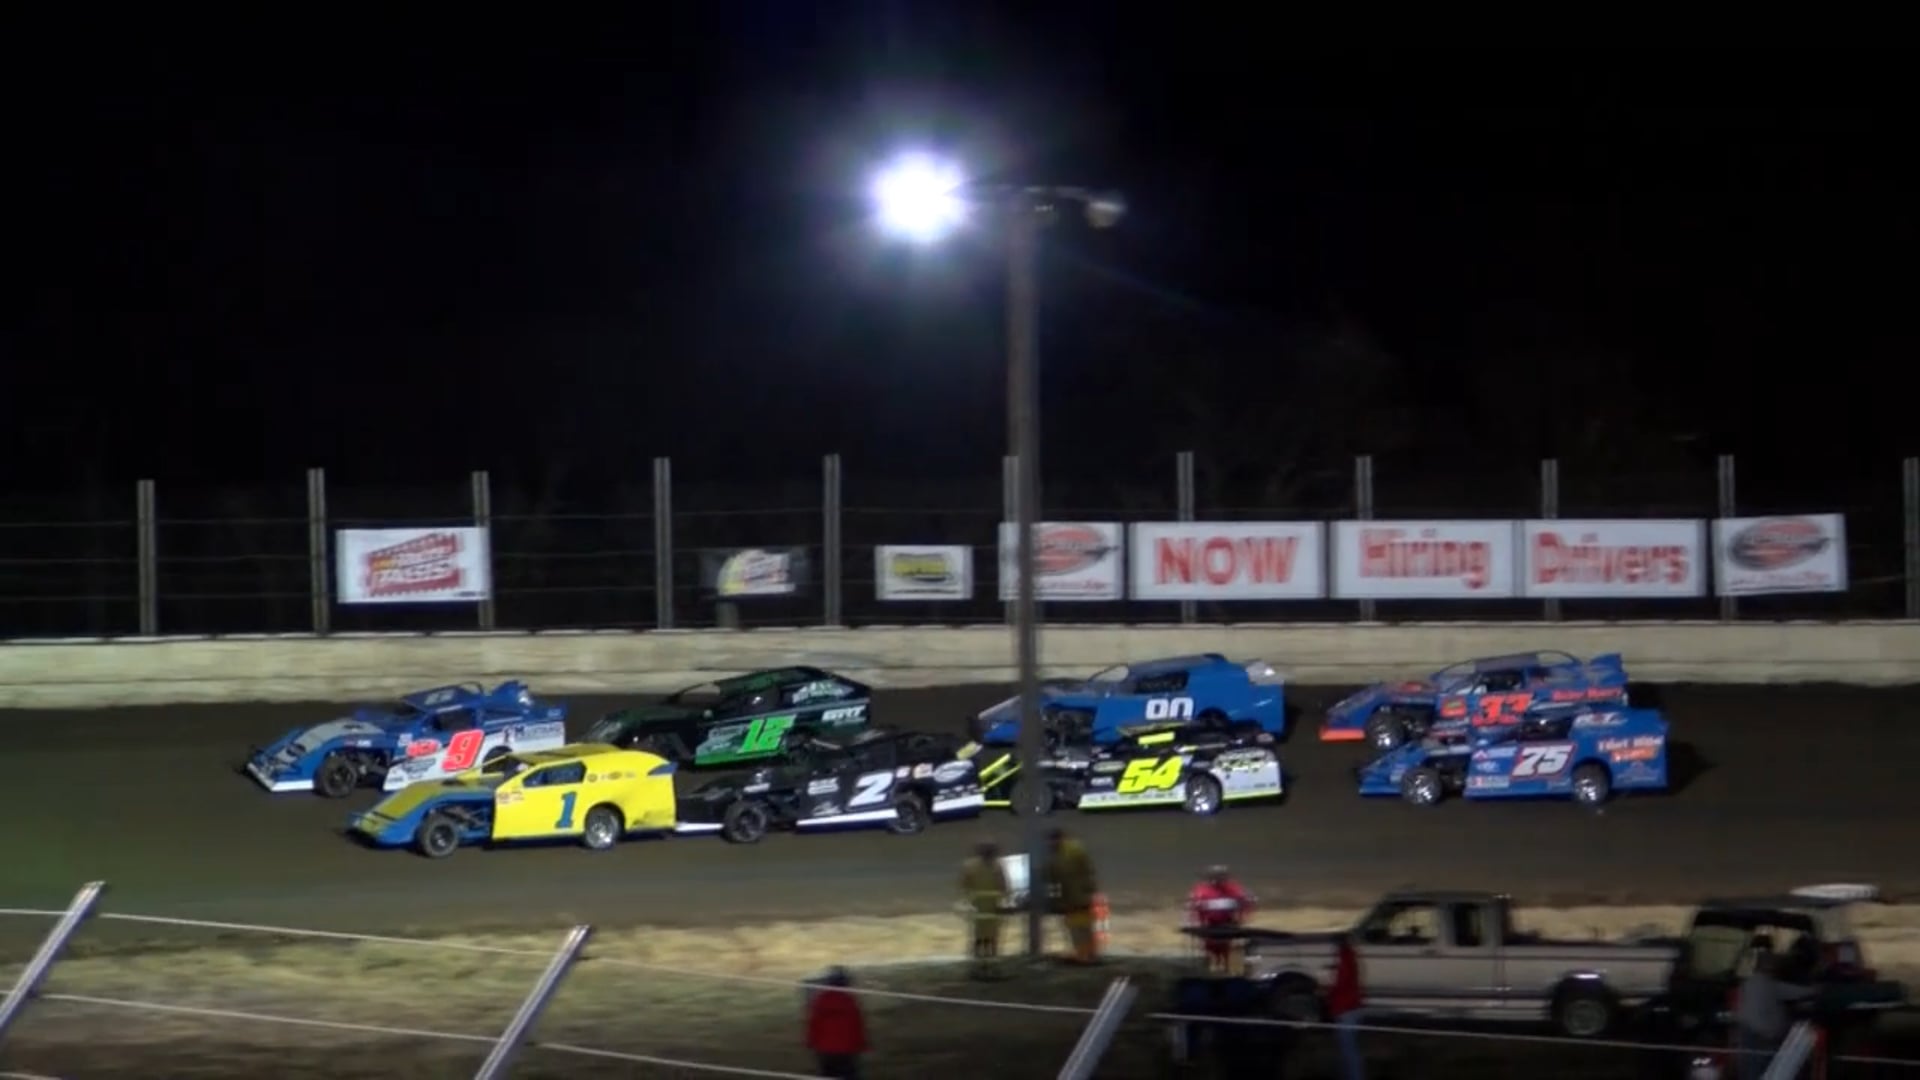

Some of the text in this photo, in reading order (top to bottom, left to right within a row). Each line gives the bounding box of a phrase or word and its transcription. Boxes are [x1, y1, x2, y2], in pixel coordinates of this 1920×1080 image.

[1155, 536, 1298, 585] NOW
[1360, 529, 1491, 589] Hiring
[1532, 532, 1687, 584] Drivers
[441, 729, 484, 772] 9
[737, 714, 797, 753] 12
[1116, 756, 1185, 793] 54
[1511, 745, 1573, 777] 75
[848, 771, 894, 807] 2
[555, 791, 577, 828] 1
